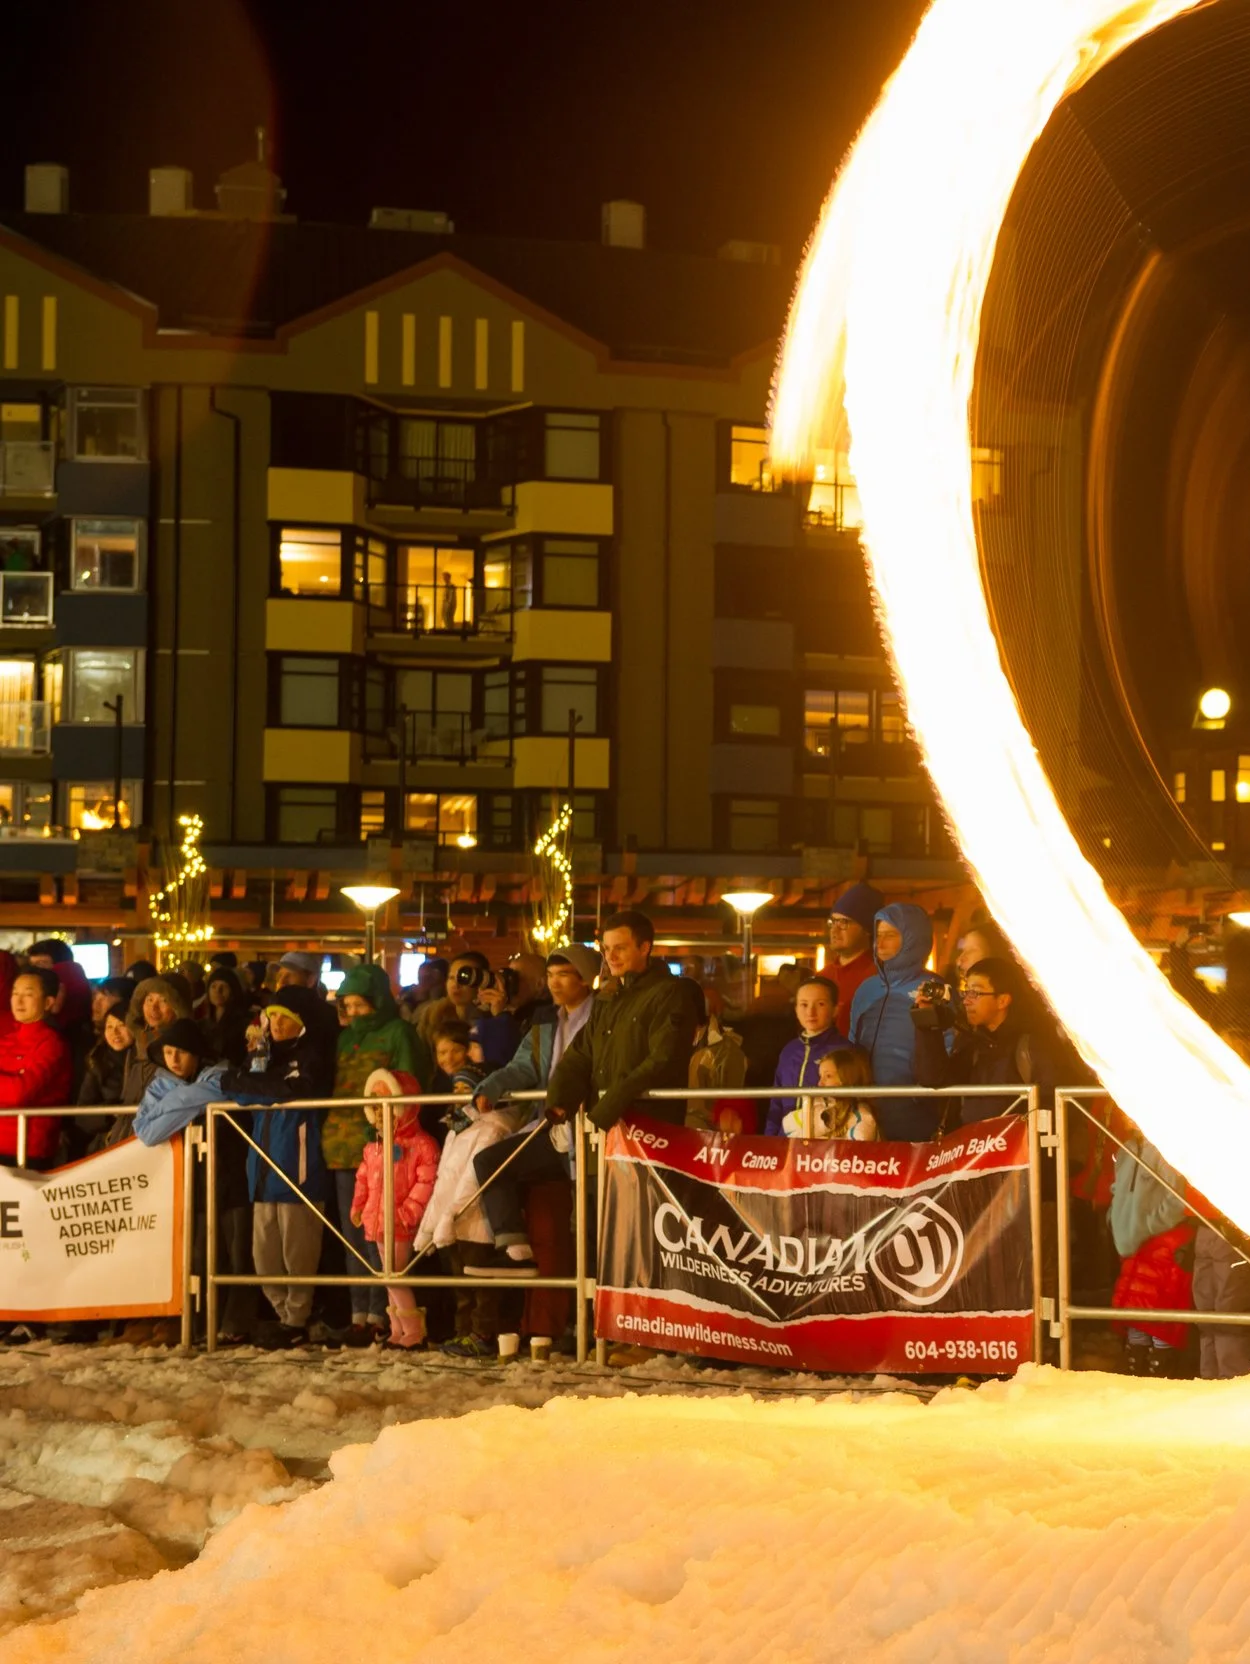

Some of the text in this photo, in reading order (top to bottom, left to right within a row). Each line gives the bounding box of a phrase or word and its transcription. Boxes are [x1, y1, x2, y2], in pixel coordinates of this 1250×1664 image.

[626, 1124, 669, 1149] Jeep
[693, 1146, 730, 1166] ATV
[741, 1151, 778, 1170] Canoe
[796, 1154, 900, 1175] Horseback
[925, 1134, 1007, 1171] Salmon Bake
[42, 1174, 149, 1203] WHISTLER'S
[50, 1196, 133, 1221] ULTIMATE
[59, 1214, 157, 1239] ADRENALINE
[654, 1202, 877, 1276] CANADIAN
[65, 1239, 115, 1258] RUSH!
[660, 1251, 866, 1298] WILDERNESS ADVENTURES
[616, 1313, 793, 1357] canadianwilderness.com
[904, 1340, 1018, 1360] 604-938-1616
